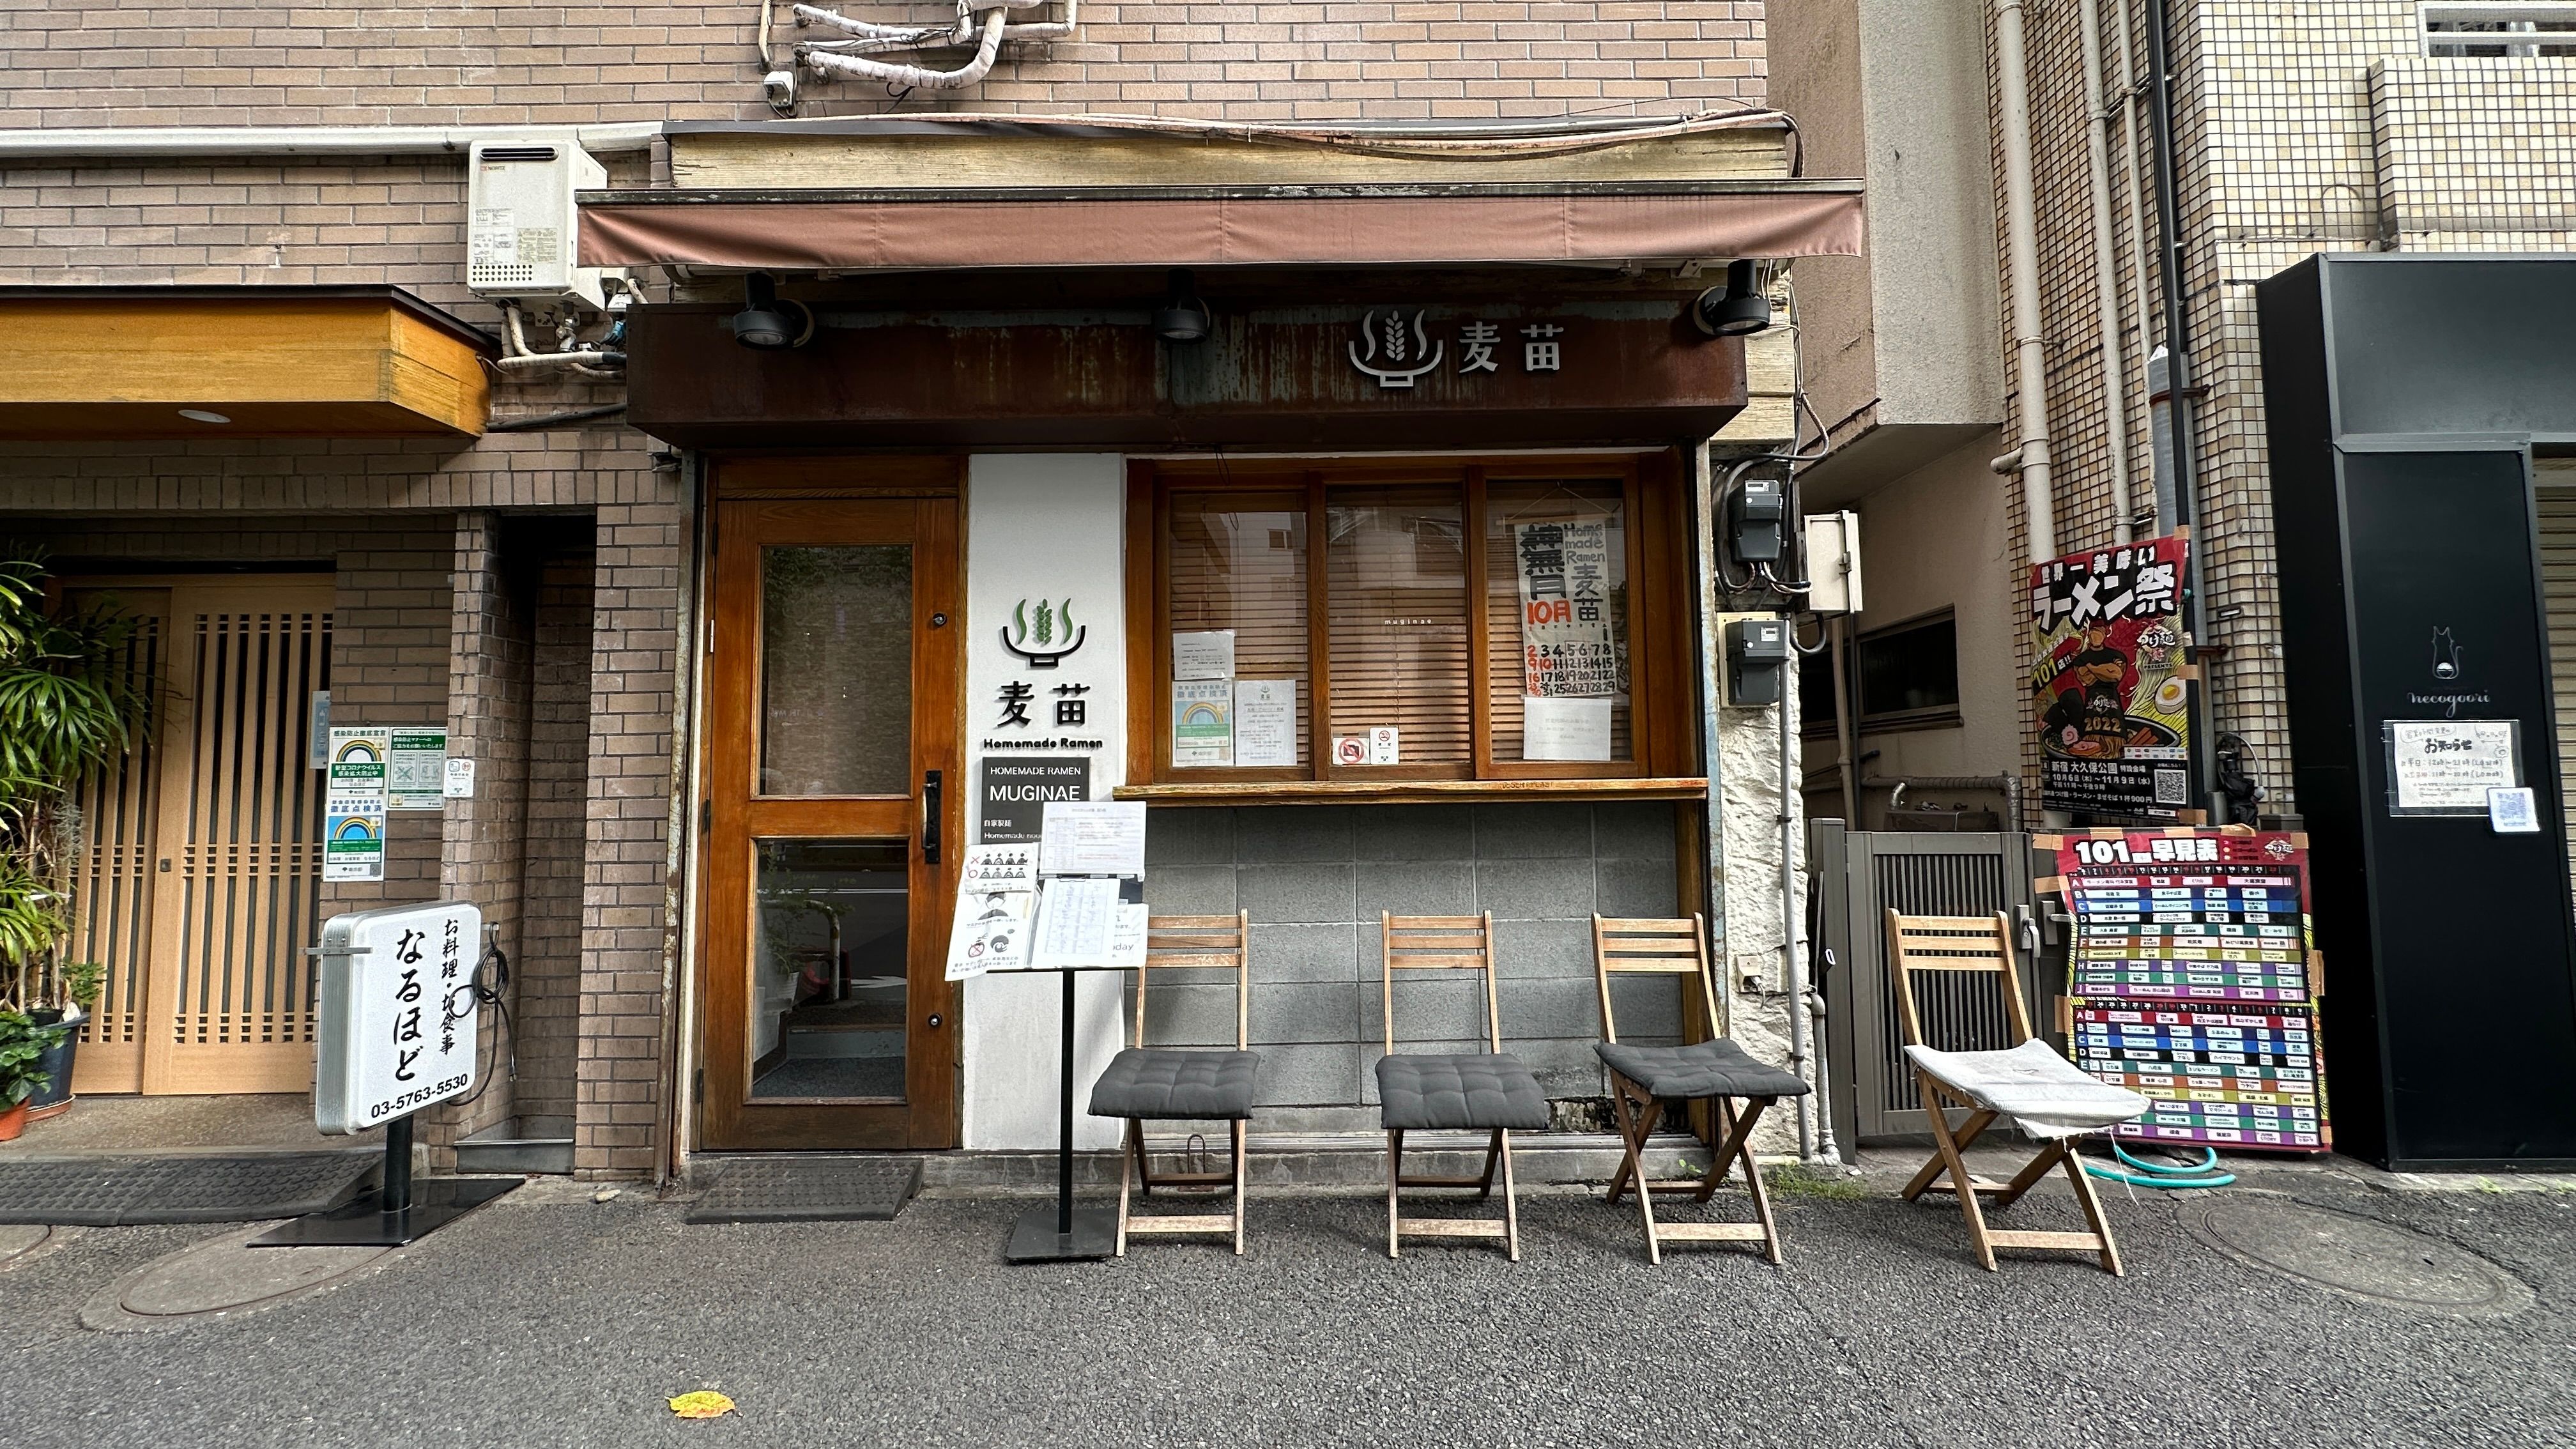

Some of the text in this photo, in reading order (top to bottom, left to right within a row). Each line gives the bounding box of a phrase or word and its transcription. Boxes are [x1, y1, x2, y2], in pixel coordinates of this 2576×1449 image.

[1459, 321, 1564, 373] 麦苗
[1565, 538, 1604, 549] made
[1566, 551, 1606, 564] Ramen
[2041, 546, 2156, 584] 世界一美味い
[2034, 564, 2175, 631] ラーメン祭
[1527, 599, 1572, 624] 10月
[1528, 643, 1611, 657] 2 3 4 5 6 7 8
[1528, 657, 1613, 671] 9 10 11 12 13 14 15
[1529, 670, 1614, 683] 16 17 18 19 20 21 22
[1554, 684, 1565, 693] 25
[1566, 684, 1578, 693] 26
[1579, 684, 1590, 693] 27
[1590, 683, 1602, 692] 28
[1603, 682, 1615, 692] 29
[997, 681, 1091, 728] 麦苗
[2407, 690, 2491, 718] necogoori
[2084, 716, 2121, 733] 2022
[984, 738, 1103, 748] Homemade Ramen
[2424, 738, 2472, 754] お知らせ
[990, 767, 1081, 775] HOMEMADE RAMEN
[2051, 762, 2068, 772] 新宿
[2071, 762, 2118, 774] 大久保公園
[990, 785, 1080, 801] MUGINAE
[2076, 841, 2130, 864] 101
[2080, 939, 2087, 947] F
[2077, 985, 2082, 993] J
[394, 929, 425, 1082] なるほど
[2080, 1060, 2088, 1069] E
[371, 1073, 468, 1119] 03-5763-5530
